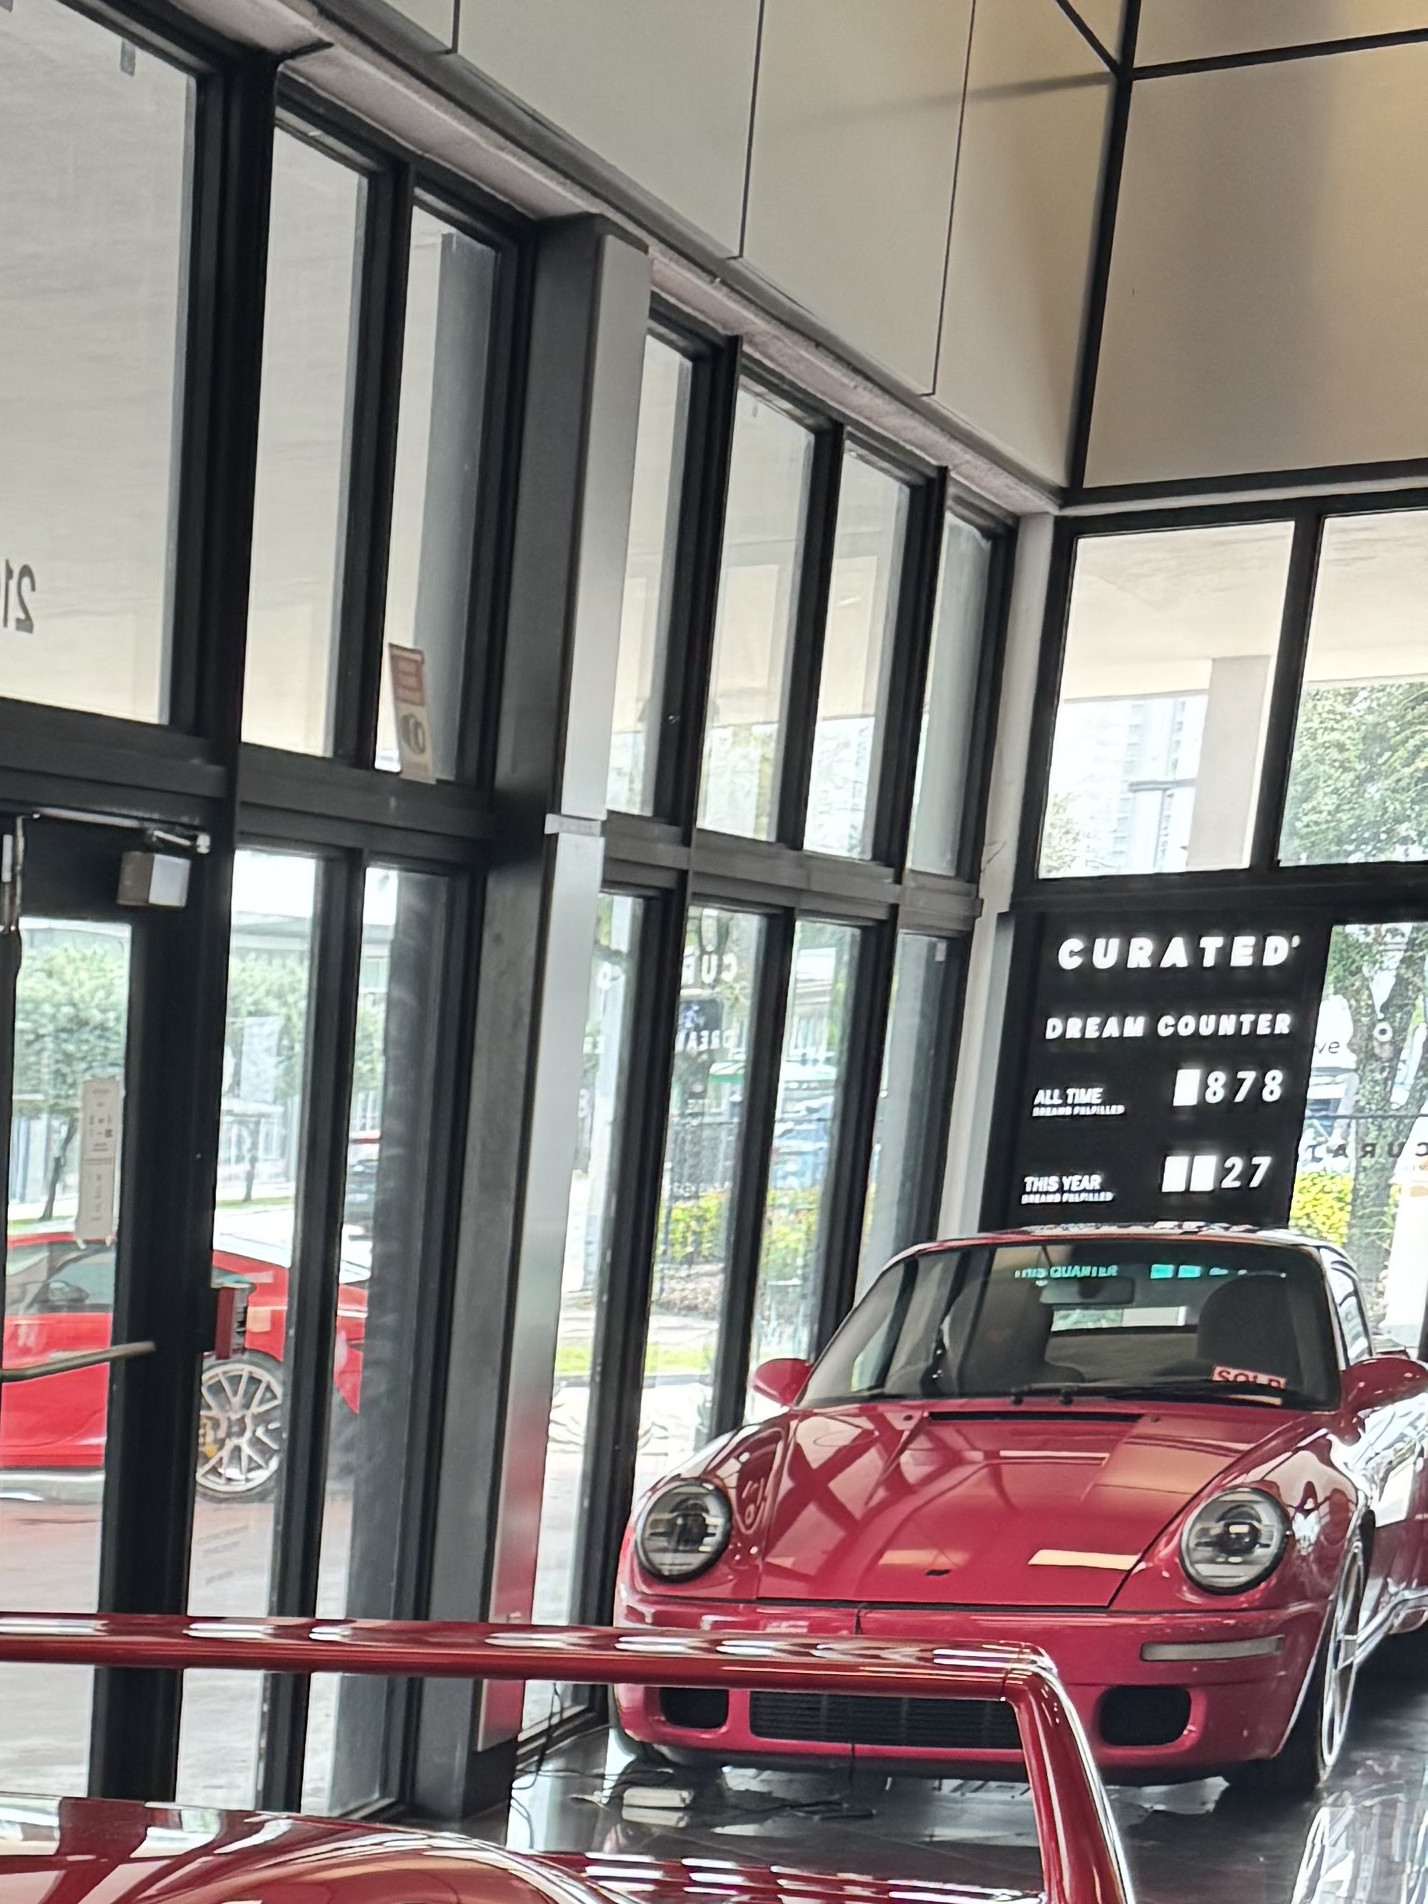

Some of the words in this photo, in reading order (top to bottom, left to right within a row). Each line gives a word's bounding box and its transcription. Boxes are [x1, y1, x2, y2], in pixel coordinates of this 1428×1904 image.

[1058, 935, 1290, 970] CURATED
[1045, 1016, 1145, 1040] DREAM
[1157, 1013, 1292, 1036] COUNTER
[1034, 1088, 1063, 1105] ALL
[1066, 1087, 1104, 1104] TIME
[1204, 1069, 1283, 1104] 878
[1024, 1176, 1060, 1192] THIS
[1062, 1174, 1102, 1190] YEAR
[1221, 1156, 1272, 1189] 27
